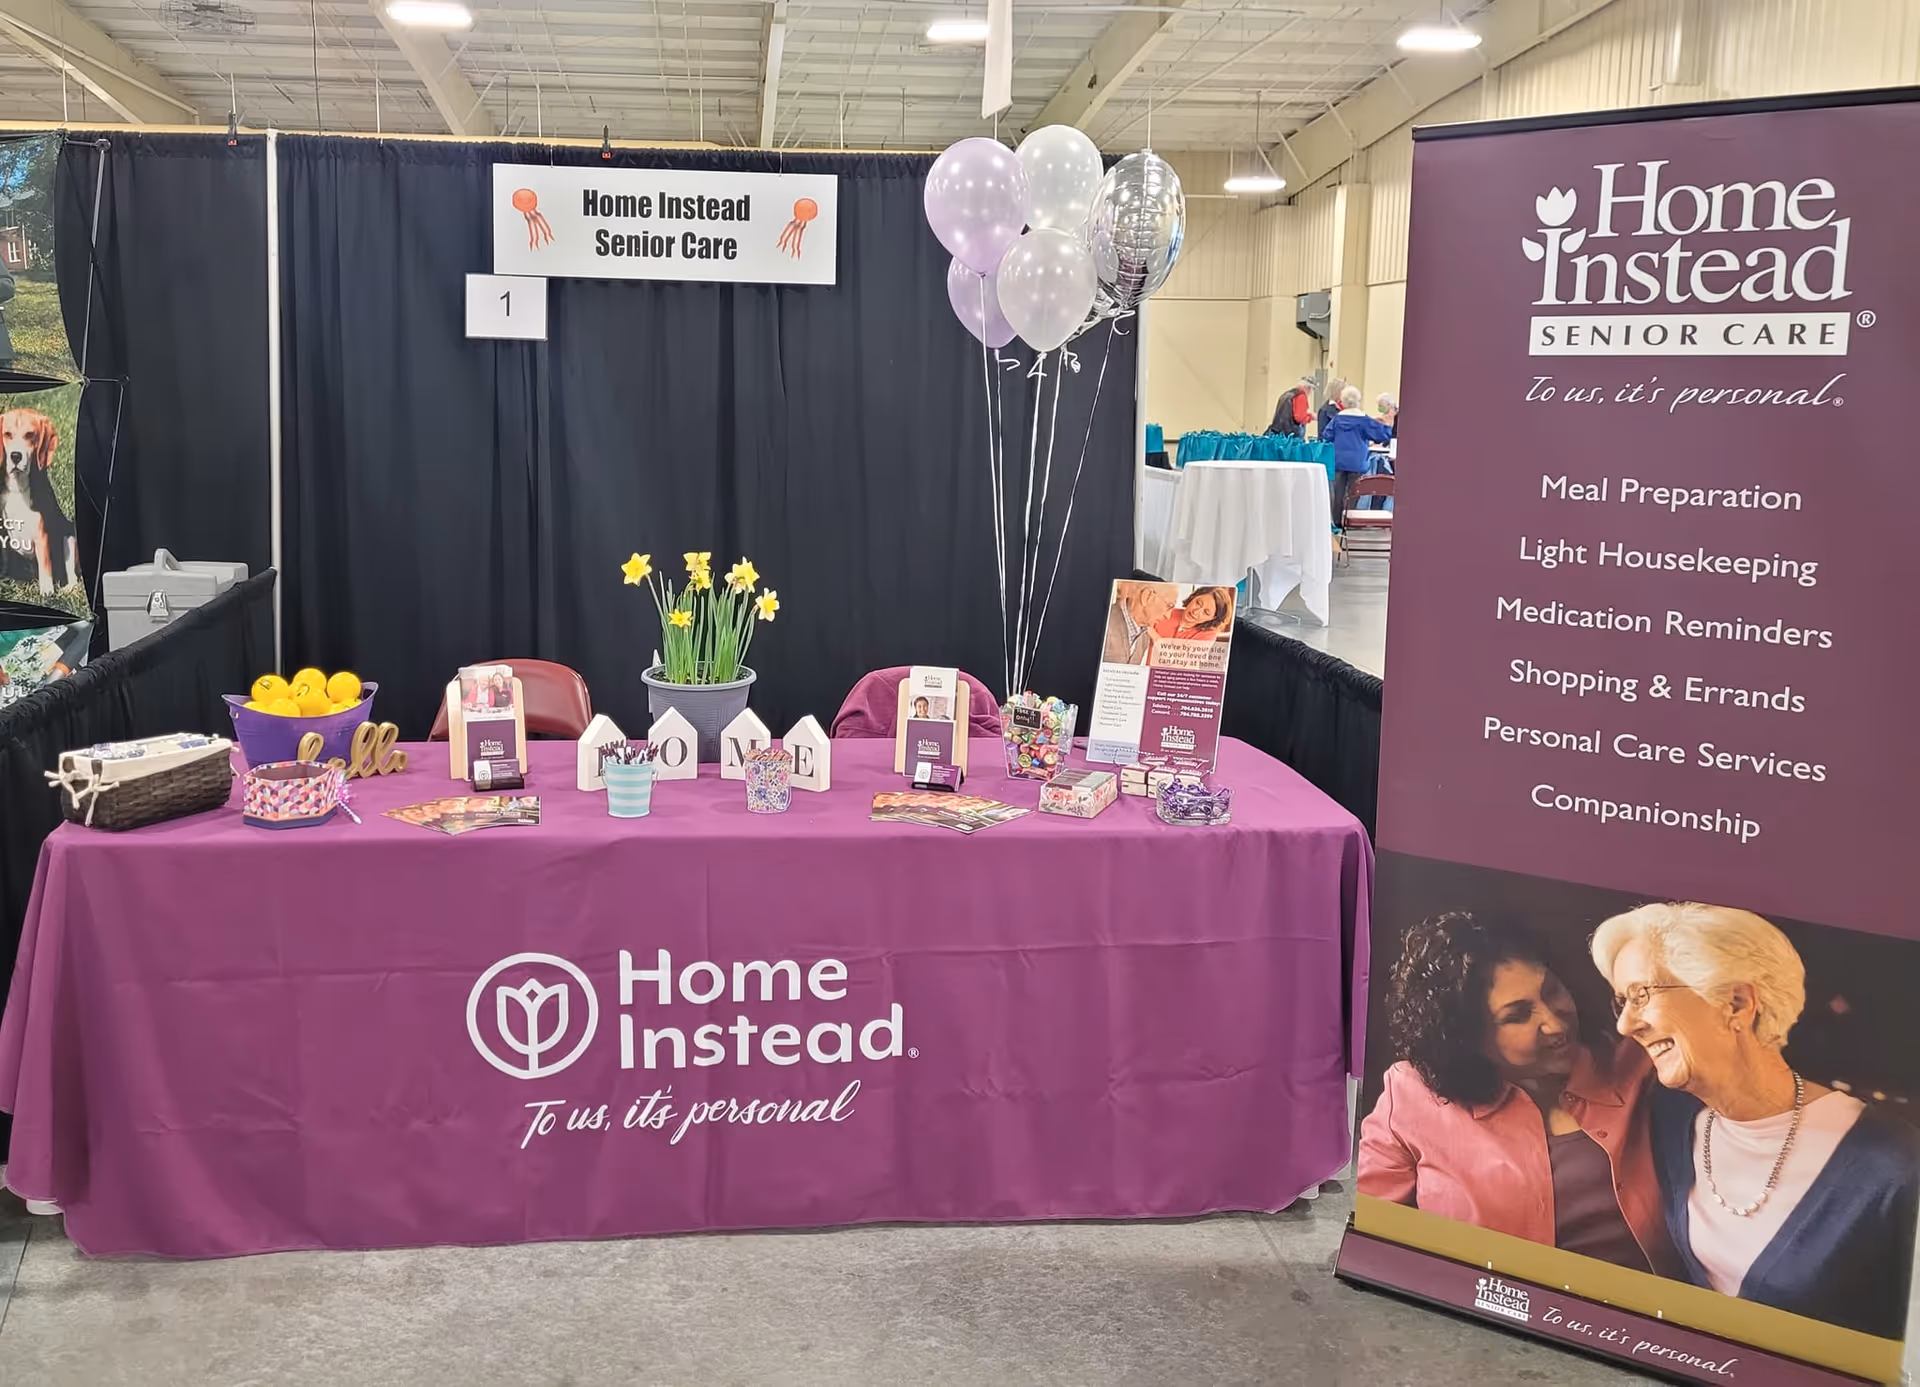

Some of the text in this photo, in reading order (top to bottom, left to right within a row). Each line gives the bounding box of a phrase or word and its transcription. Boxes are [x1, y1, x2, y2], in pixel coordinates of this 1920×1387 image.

[582, 188, 751, 222] Home Instead
[1588, 159, 1837, 238] Home
[595, 229, 738, 260] Senior Care
[1531, 216, 1853, 306] Instead
[499, 290, 511, 317] 1
[1541, 322, 1837, 347] SENIOR CARE
[1524, 375, 1557, 402] To
[1563, 386, 1605, 404] us,
[1614, 375, 1665, 404] it's
[1540, 474, 1803, 513] Meal Preparation
[1519, 536, 1819, 587] Light Housekeeping
[1496, 596, 1834, 649] Medication Reminders
[1172, 659, 1188, 667] stay
[1182, 643, 1192, 652] by
[1210, 646, 1226, 654] side
[1187, 652, 1207, 660] loved
[1509, 658, 1806, 713] Shopping & Errands
[1169, 725, 1195, 737] Home
[1483, 716, 1827, 782] Personal Care Services
[1530, 784, 1761, 844] Companionship
[619, 948, 848, 1005] Home
[619, 1002, 903, 1069] Instead
[520, 1079, 862, 1149] To us, it's personal
[1477, 1285, 1530, 1313] Instead
[1488, 1277, 1528, 1300] Home
[1542, 1306, 1563, 1325] To
[1566, 1320, 1593, 1336] us,
[1598, 1327, 1631, 1345] it's
